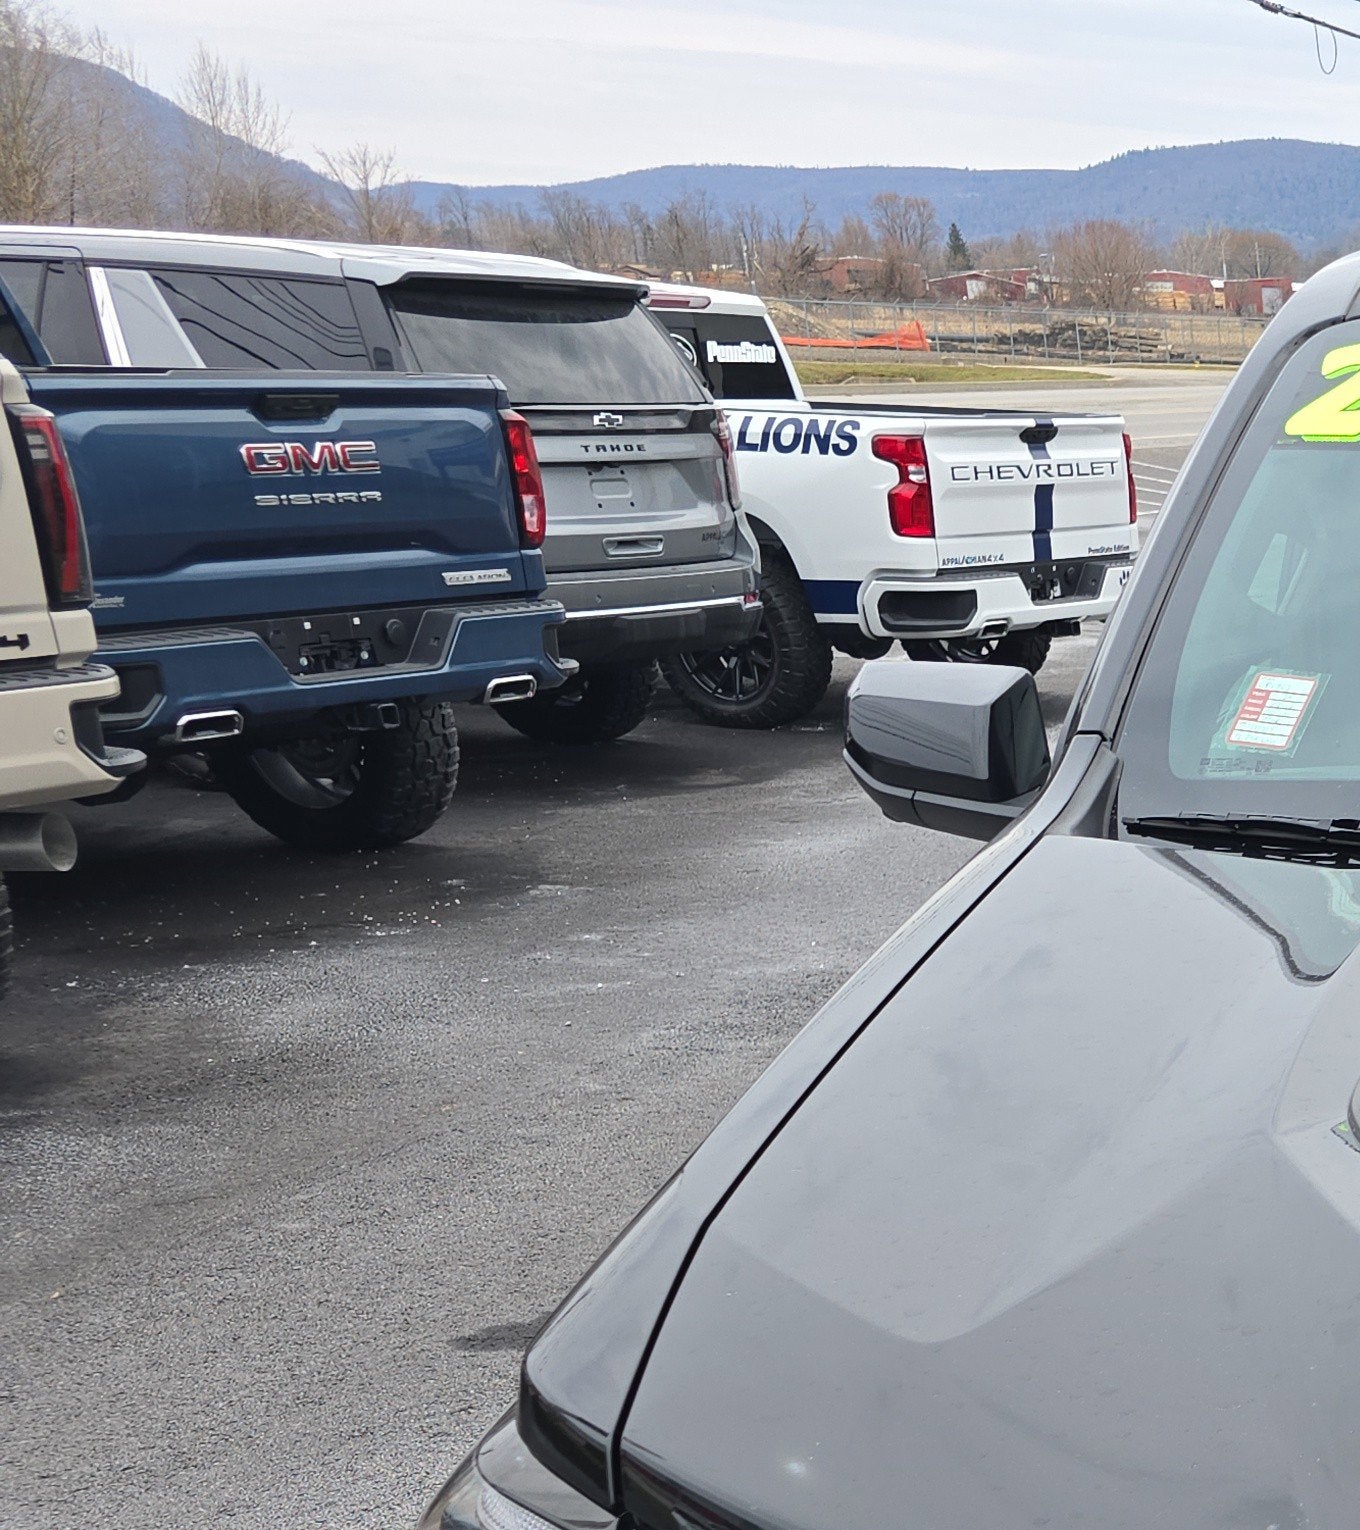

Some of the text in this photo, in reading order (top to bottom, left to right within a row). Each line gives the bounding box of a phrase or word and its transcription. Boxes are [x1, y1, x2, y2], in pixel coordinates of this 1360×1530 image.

[736, 415, 861, 457] LIONS
[239, 440, 382, 475] GMC
[580, 443, 647, 453] TAHOE
[950, 460, 1119, 482] CHEVROLET
[254, 491, 382, 506] SIERRA
